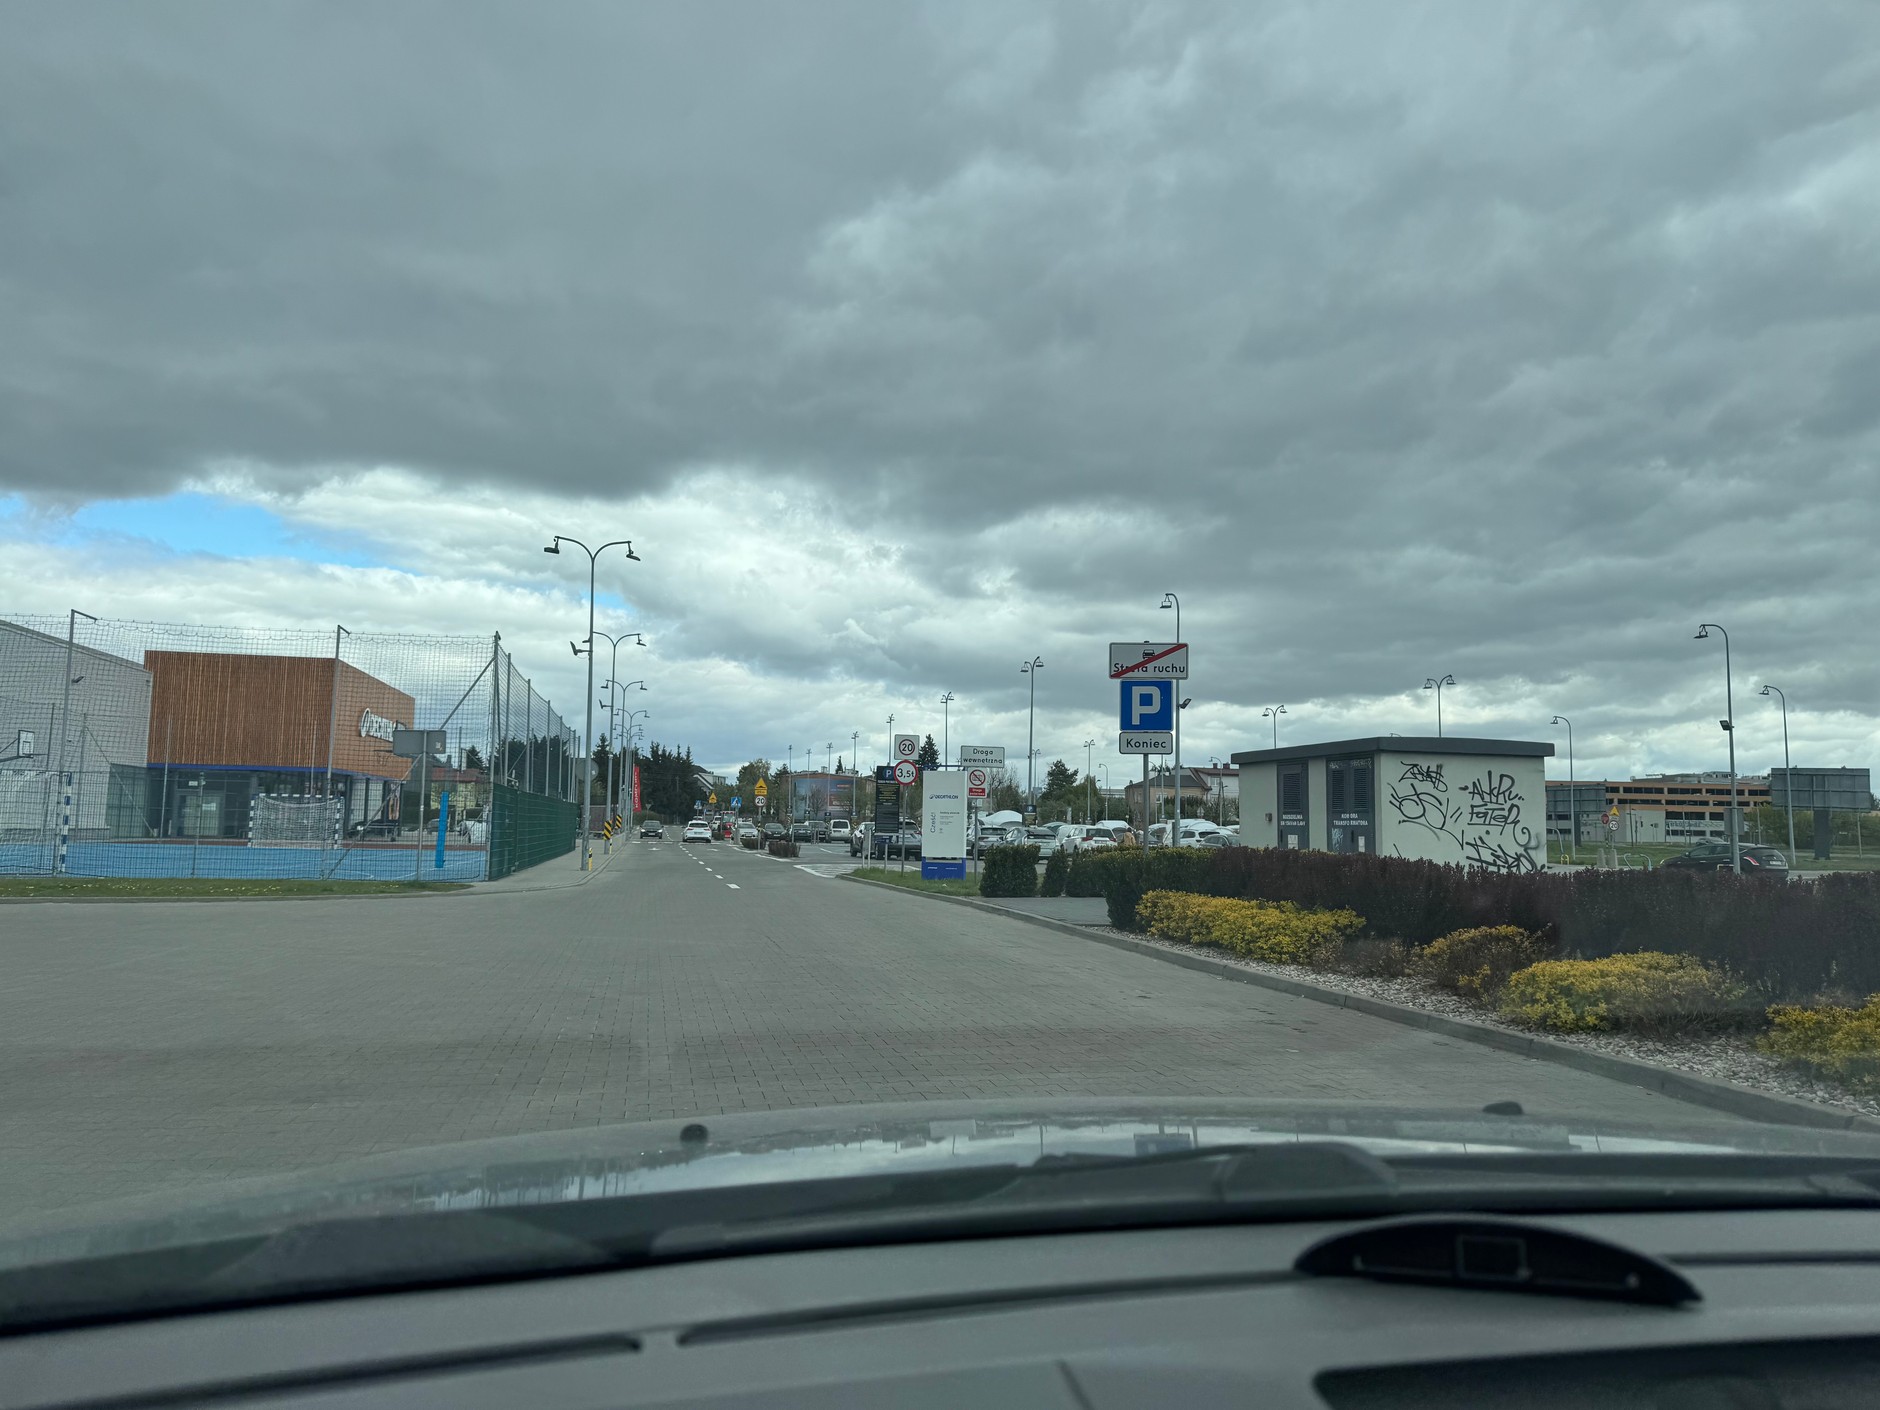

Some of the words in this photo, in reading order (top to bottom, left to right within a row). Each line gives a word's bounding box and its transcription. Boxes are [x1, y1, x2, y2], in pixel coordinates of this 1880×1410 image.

[1113, 663, 1148, 673] Sta
[1153, 663, 1185, 673] ruchu
[1132, 686, 1161, 725] P
[902, 743, 913, 752] 20
[1126, 738, 1167, 749] Koniec
[973, 748, 993, 757] Droga
[886, 770, 892, 778] P
[897, 767, 914, 779] 3,5t
